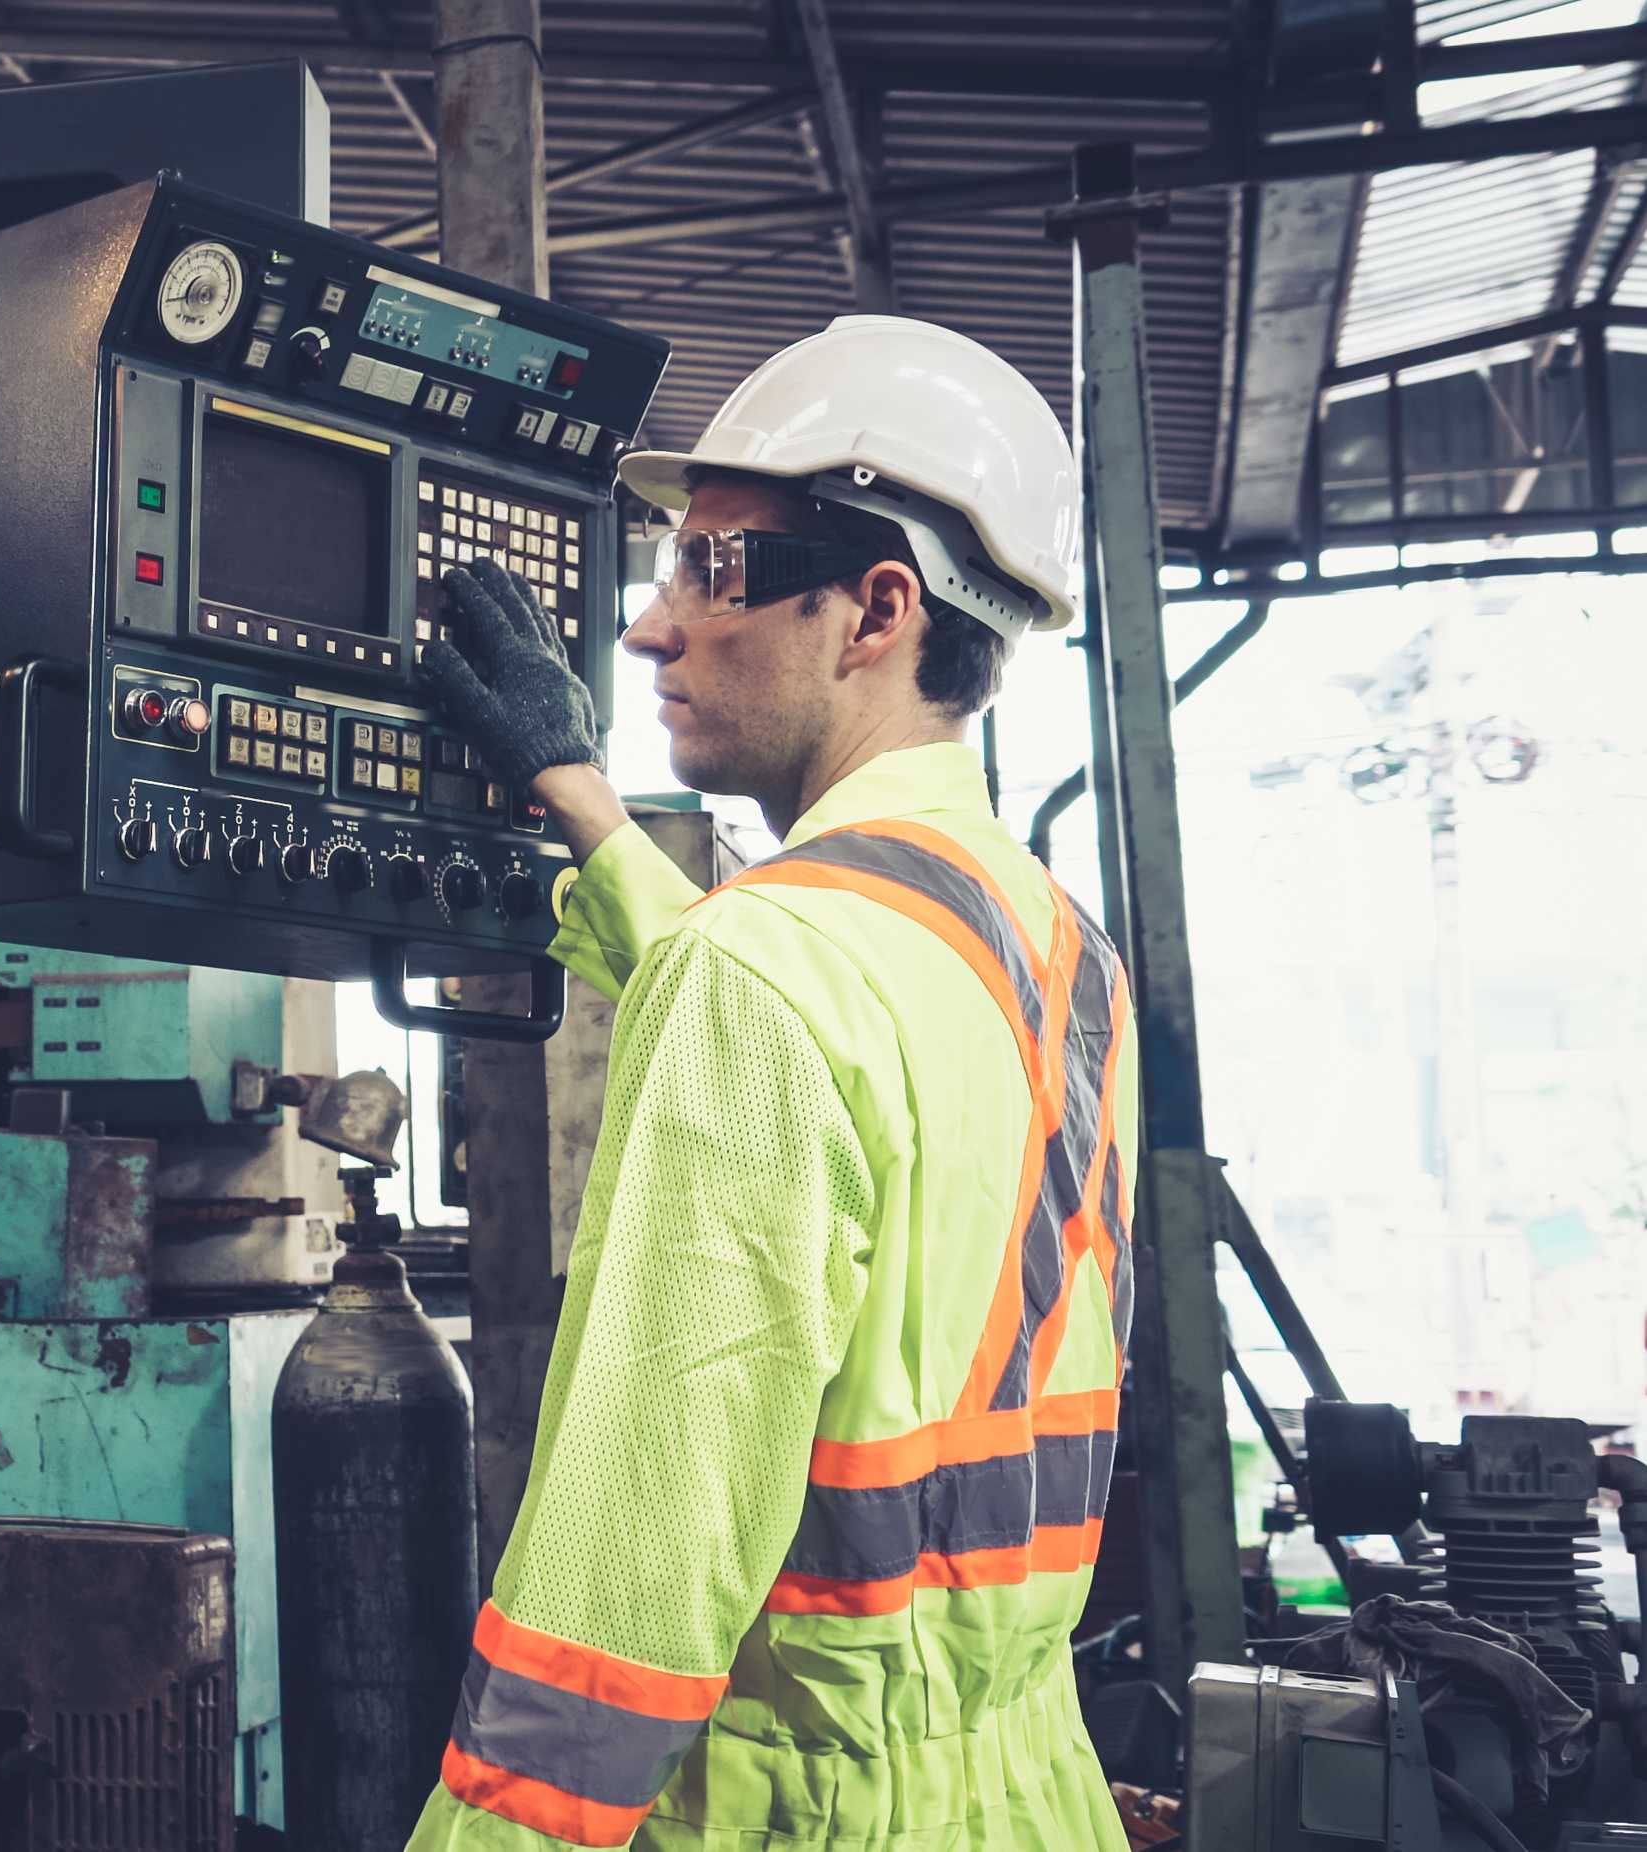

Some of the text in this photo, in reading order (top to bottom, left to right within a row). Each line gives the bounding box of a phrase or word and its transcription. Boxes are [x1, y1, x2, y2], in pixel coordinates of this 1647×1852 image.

[182, 314, 197, 325] rpm
[370, 307, 379, 317] X
[386, 311, 393, 321] Y
[455, 333, 464, 343] X
[471, 337, 478, 346] Y
[129, 786, 136, 797] X
[183, 796, 191, 806] Y
[236, 804, 243, 814] Z
[287, 813, 293, 823] 4
